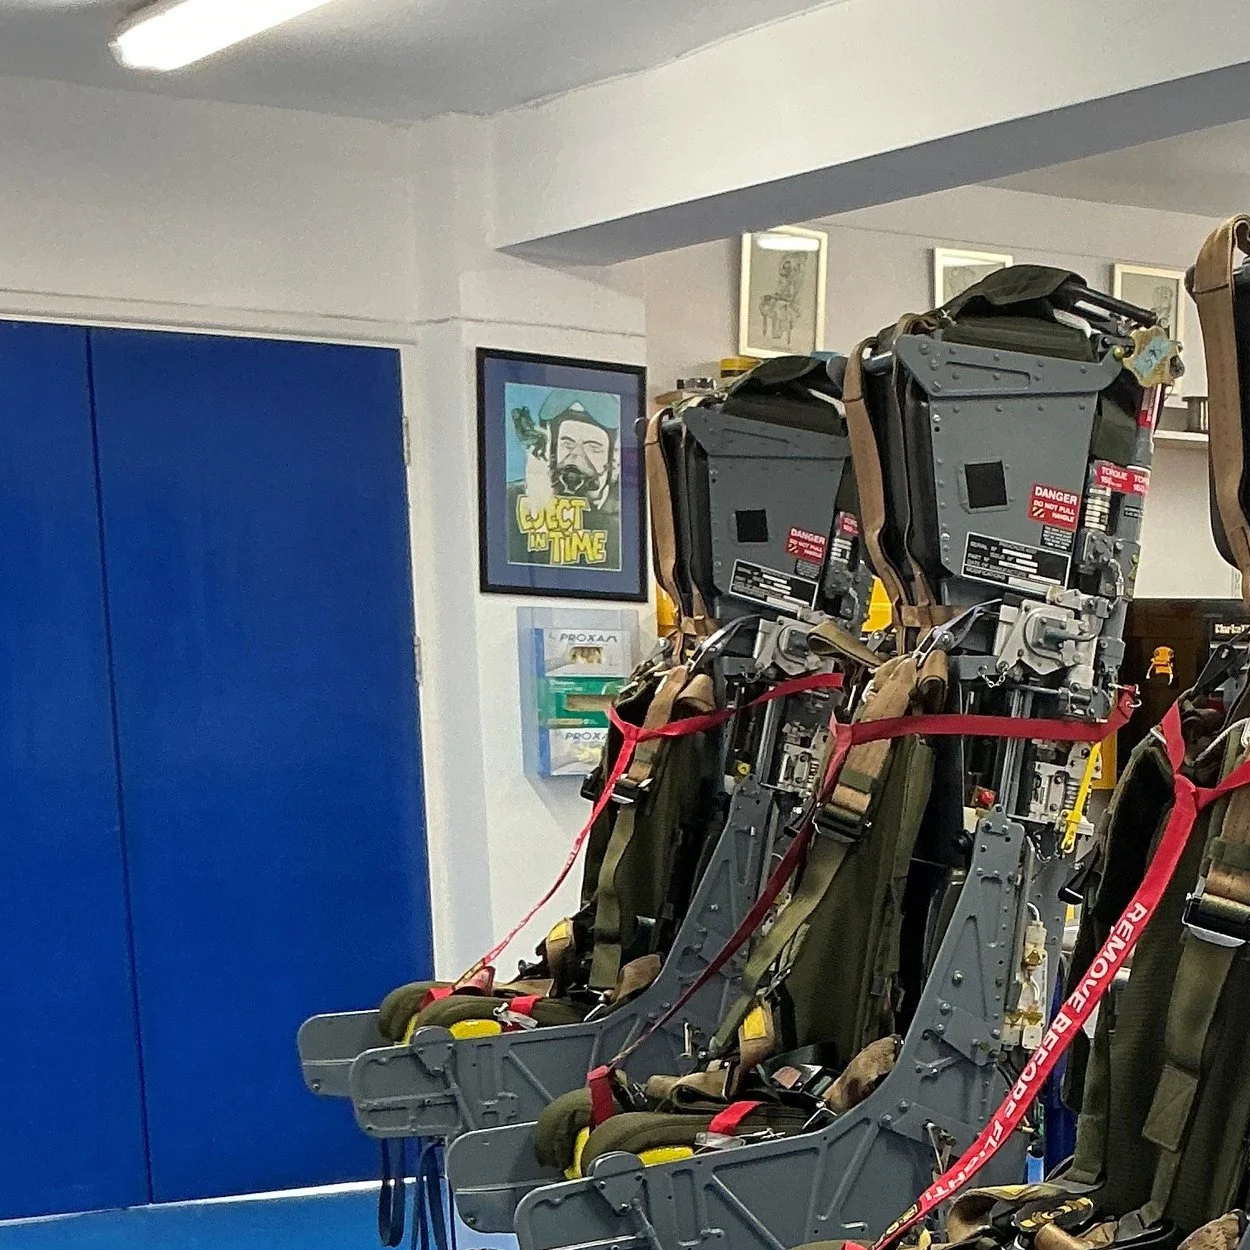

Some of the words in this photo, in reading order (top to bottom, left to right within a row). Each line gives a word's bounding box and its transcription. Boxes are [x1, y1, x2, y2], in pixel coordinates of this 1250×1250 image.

[1034, 485, 1078, 506] DANGER
[1044, 502, 1058, 511] NOT
[1059, 506, 1075, 516] PULL
[790, 528, 826, 545] DANGER
[1066, 902, 1147, 1013] REMOVE
[1004, 1012, 1073, 1119] BEFORE
